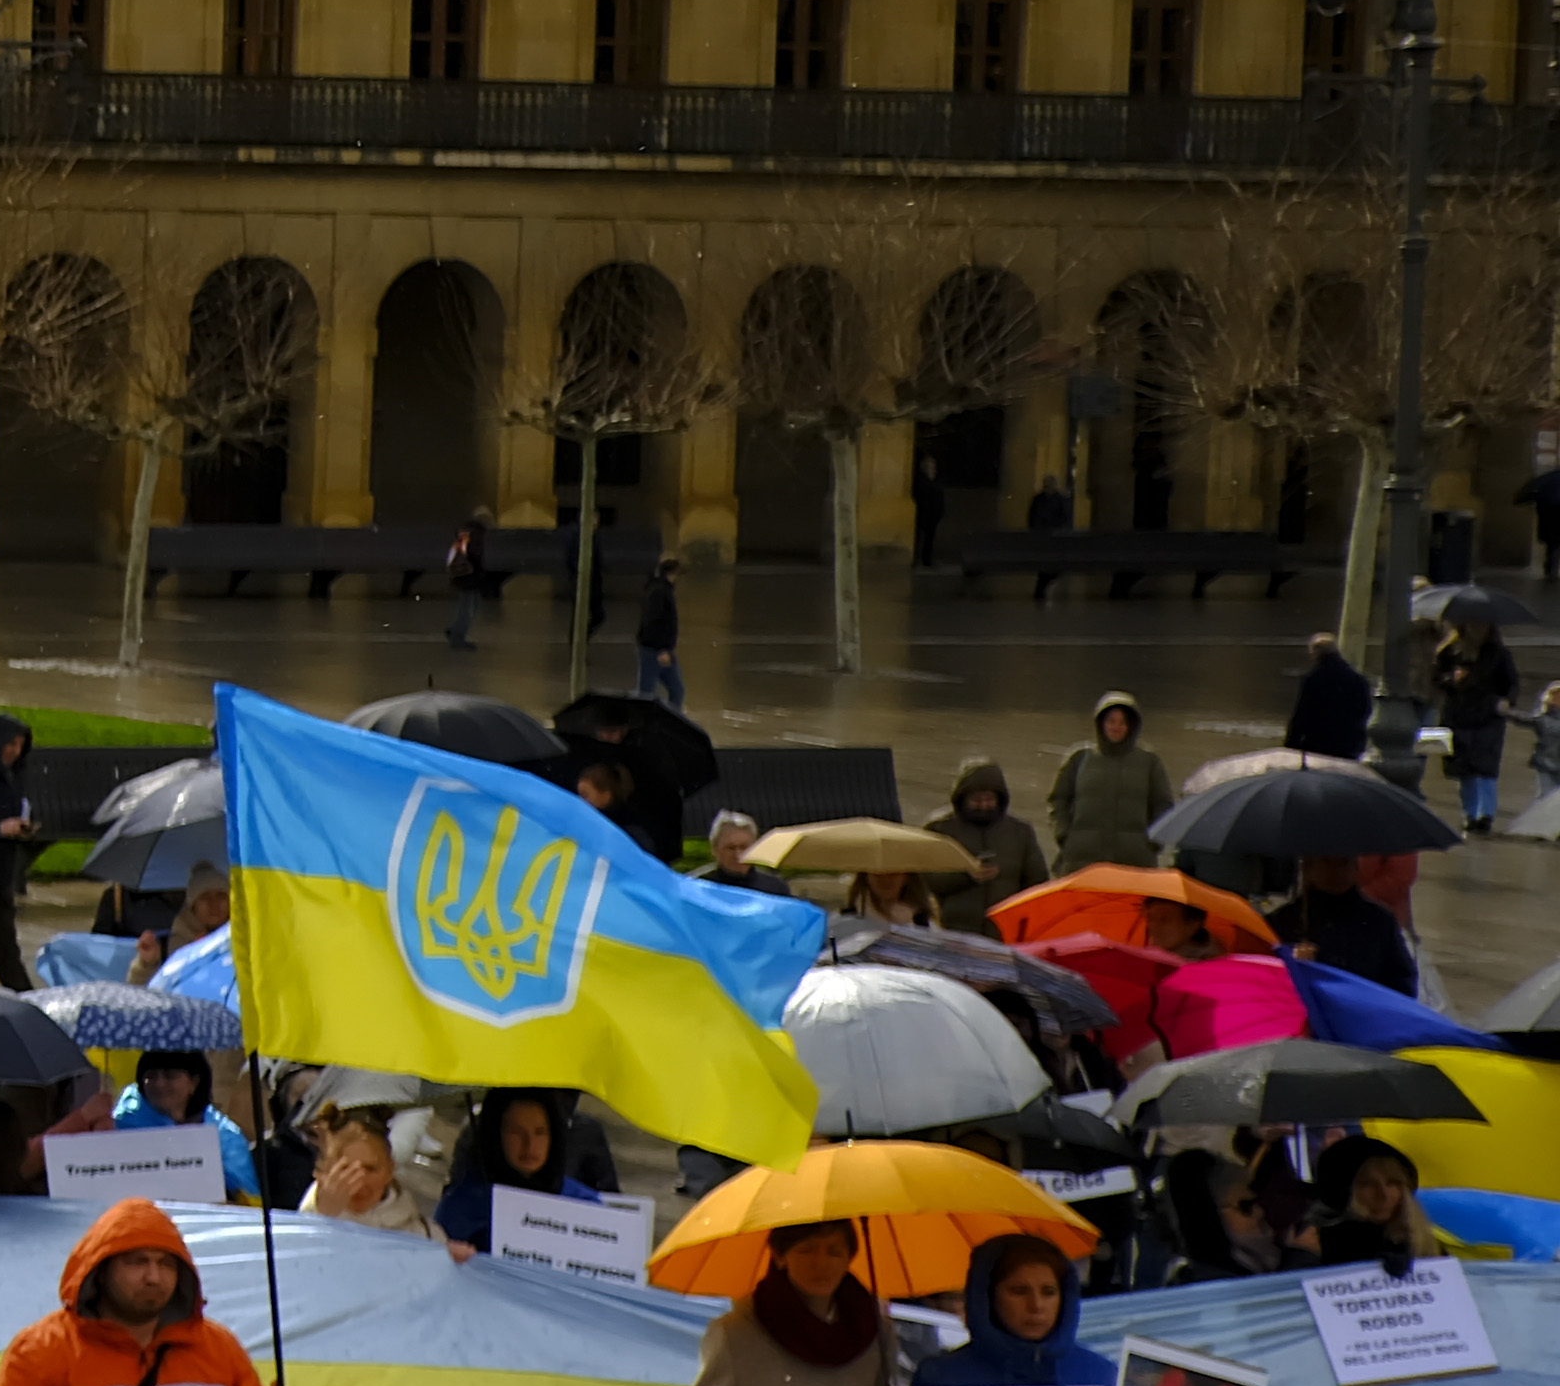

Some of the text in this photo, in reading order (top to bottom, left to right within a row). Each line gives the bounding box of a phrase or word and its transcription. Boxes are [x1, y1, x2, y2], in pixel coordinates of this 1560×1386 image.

[1314, 1271, 1441, 1297] VIOLACIONES
[1334, 1291, 1434, 1314] TORTURAS
[1359, 1312, 1423, 1331] ROBOS
